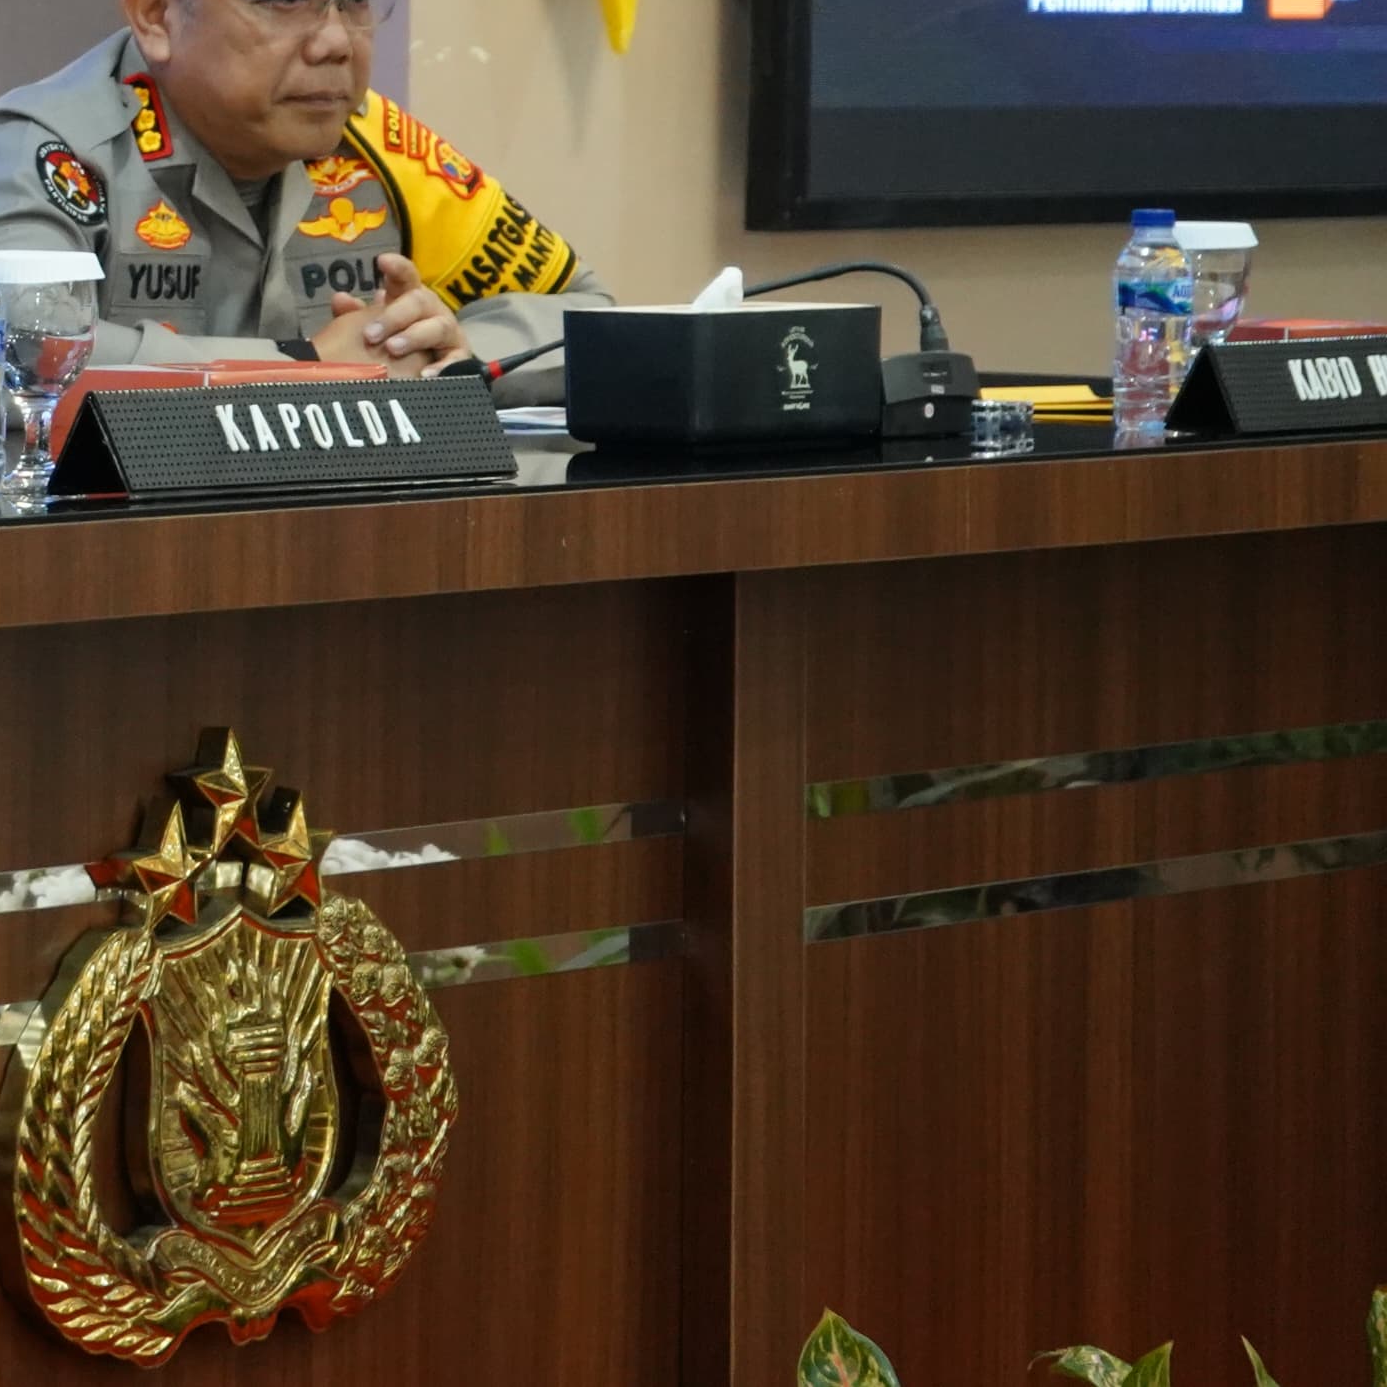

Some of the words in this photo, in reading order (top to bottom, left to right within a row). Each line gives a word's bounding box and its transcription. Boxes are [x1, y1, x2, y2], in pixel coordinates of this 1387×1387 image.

[127, 263, 202, 301] YUSUF
[1287, 355, 1363, 402] KABID
[215, 398, 422, 453] KAPOLDA
